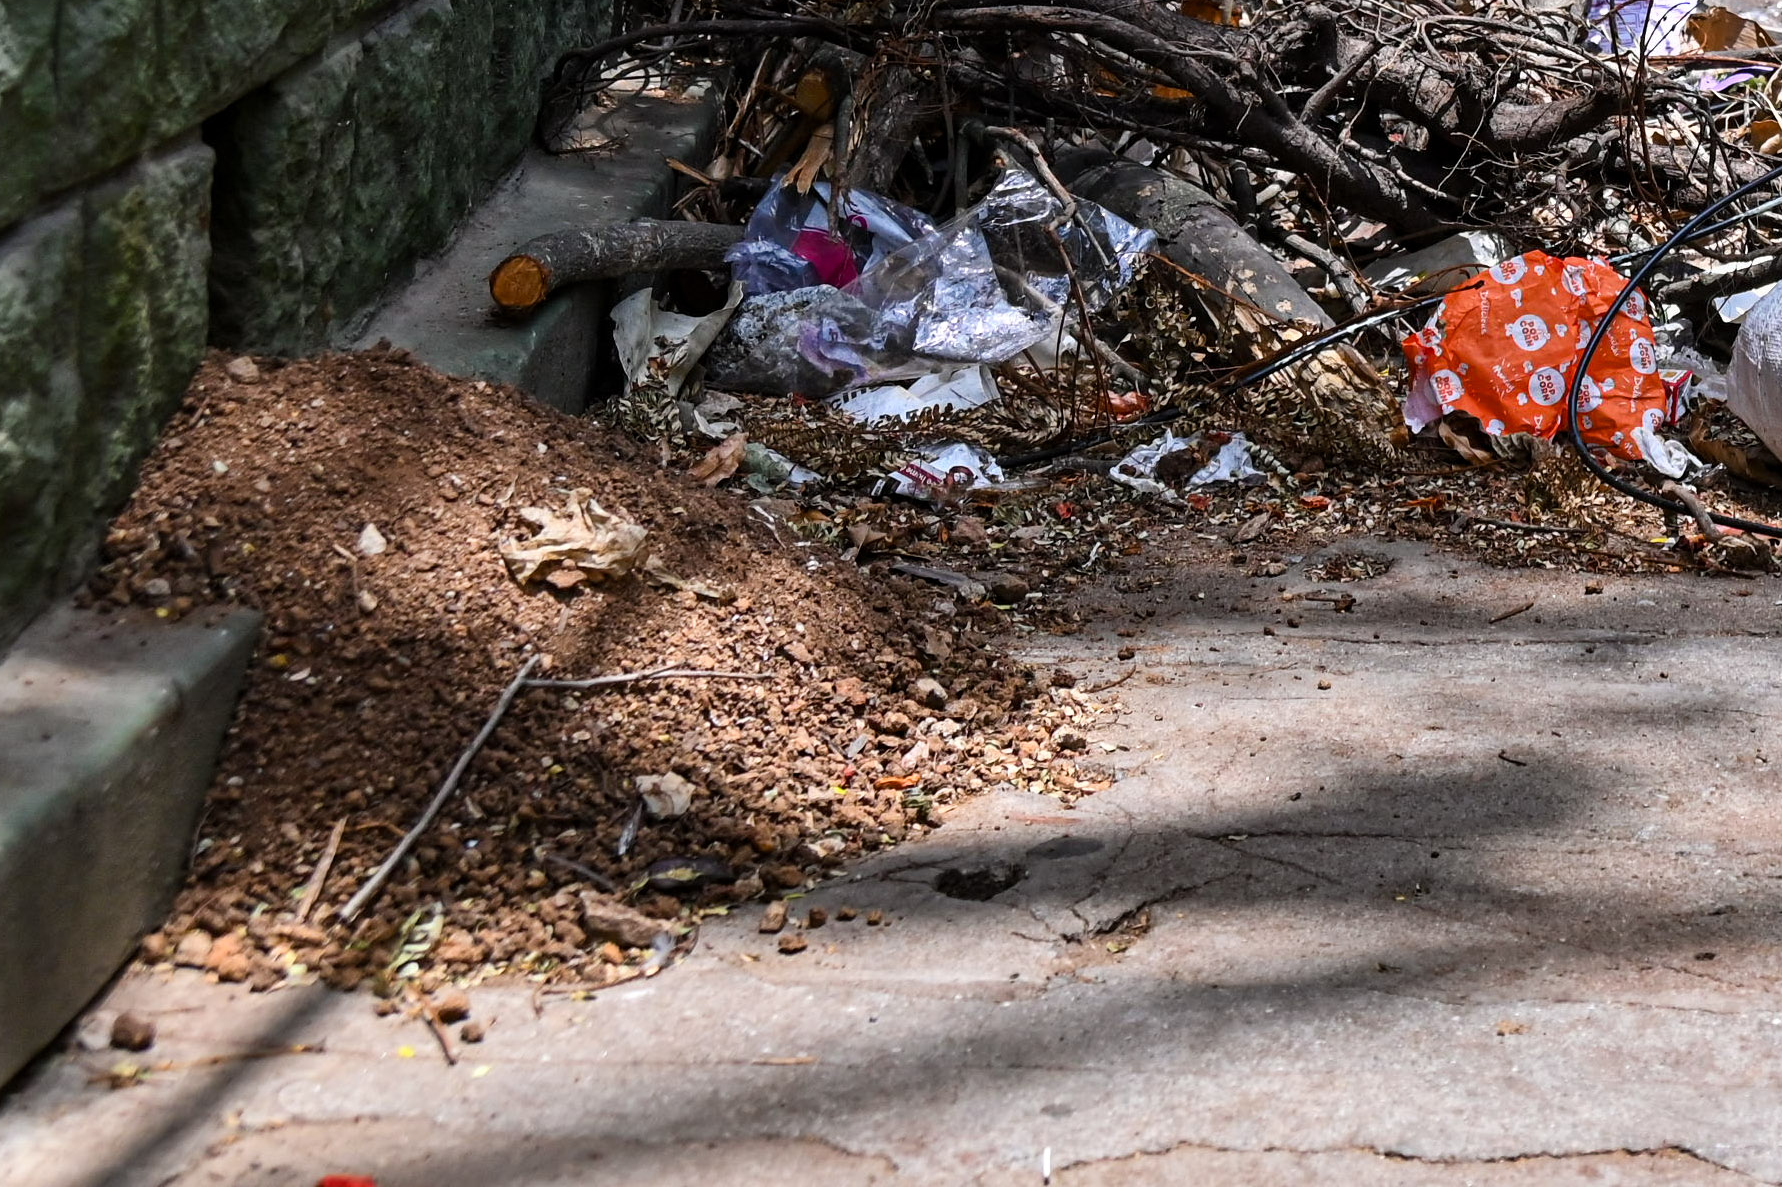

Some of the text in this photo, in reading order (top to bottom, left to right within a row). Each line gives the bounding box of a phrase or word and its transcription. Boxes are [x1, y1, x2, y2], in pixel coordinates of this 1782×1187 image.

[1520, 320, 1534, 347] CORN
[1528, 321, 1539, 341] POP
[1638, 342, 1648, 369] CORN
[1443, 376, 1454, 396] POP
[1538, 374, 1551, 401] CORN
[1545, 374, 1556, 395] POP
[1583, 384, 1591, 403] POP
